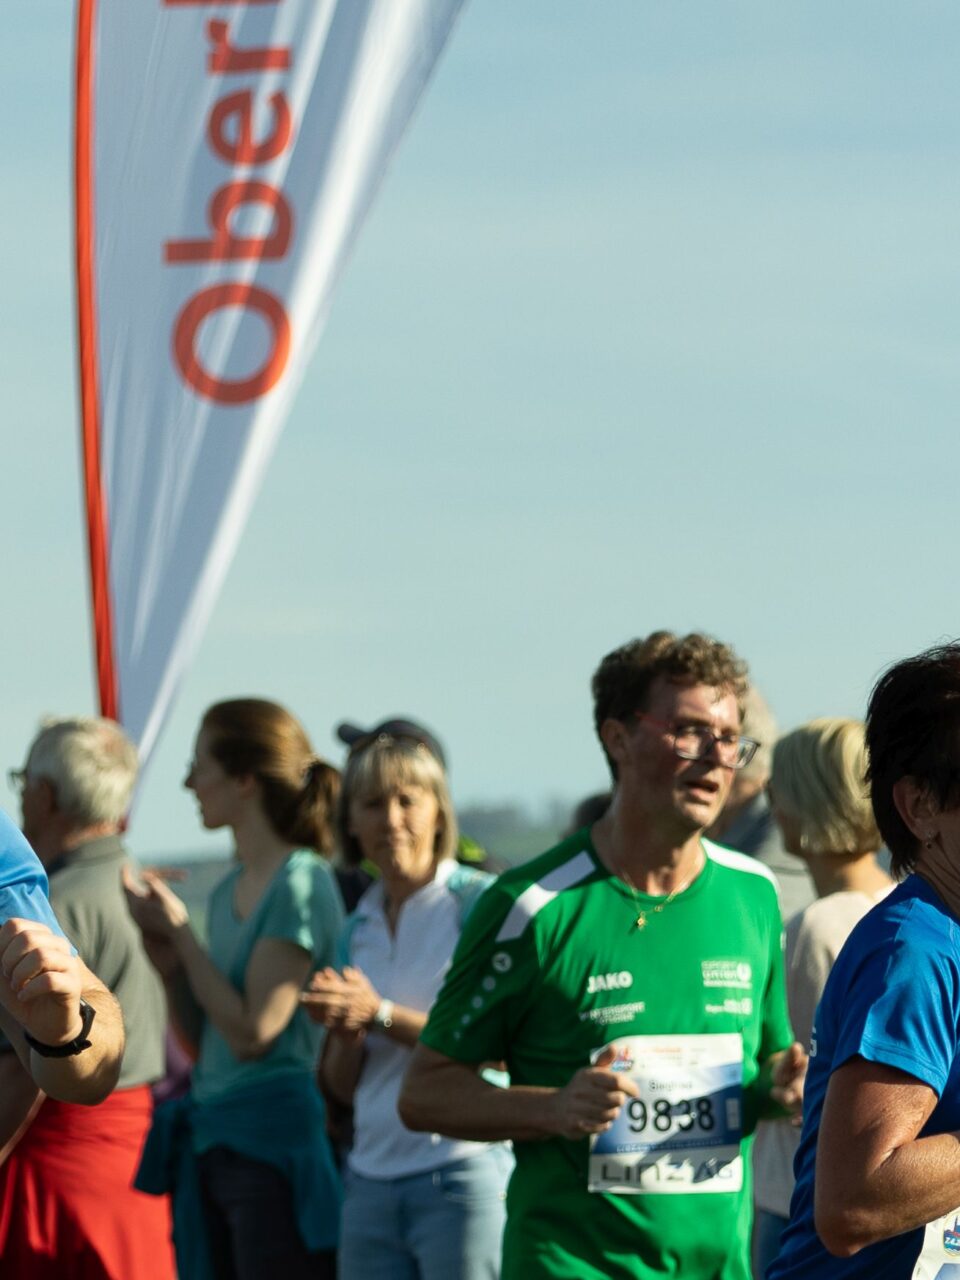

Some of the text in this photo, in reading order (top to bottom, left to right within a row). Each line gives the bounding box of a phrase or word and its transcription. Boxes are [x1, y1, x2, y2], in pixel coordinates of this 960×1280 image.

[162, 0, 294, 407] Ober
[587, 970, 633, 994] JAKO
[628, 1096, 715, 1133] 9838
